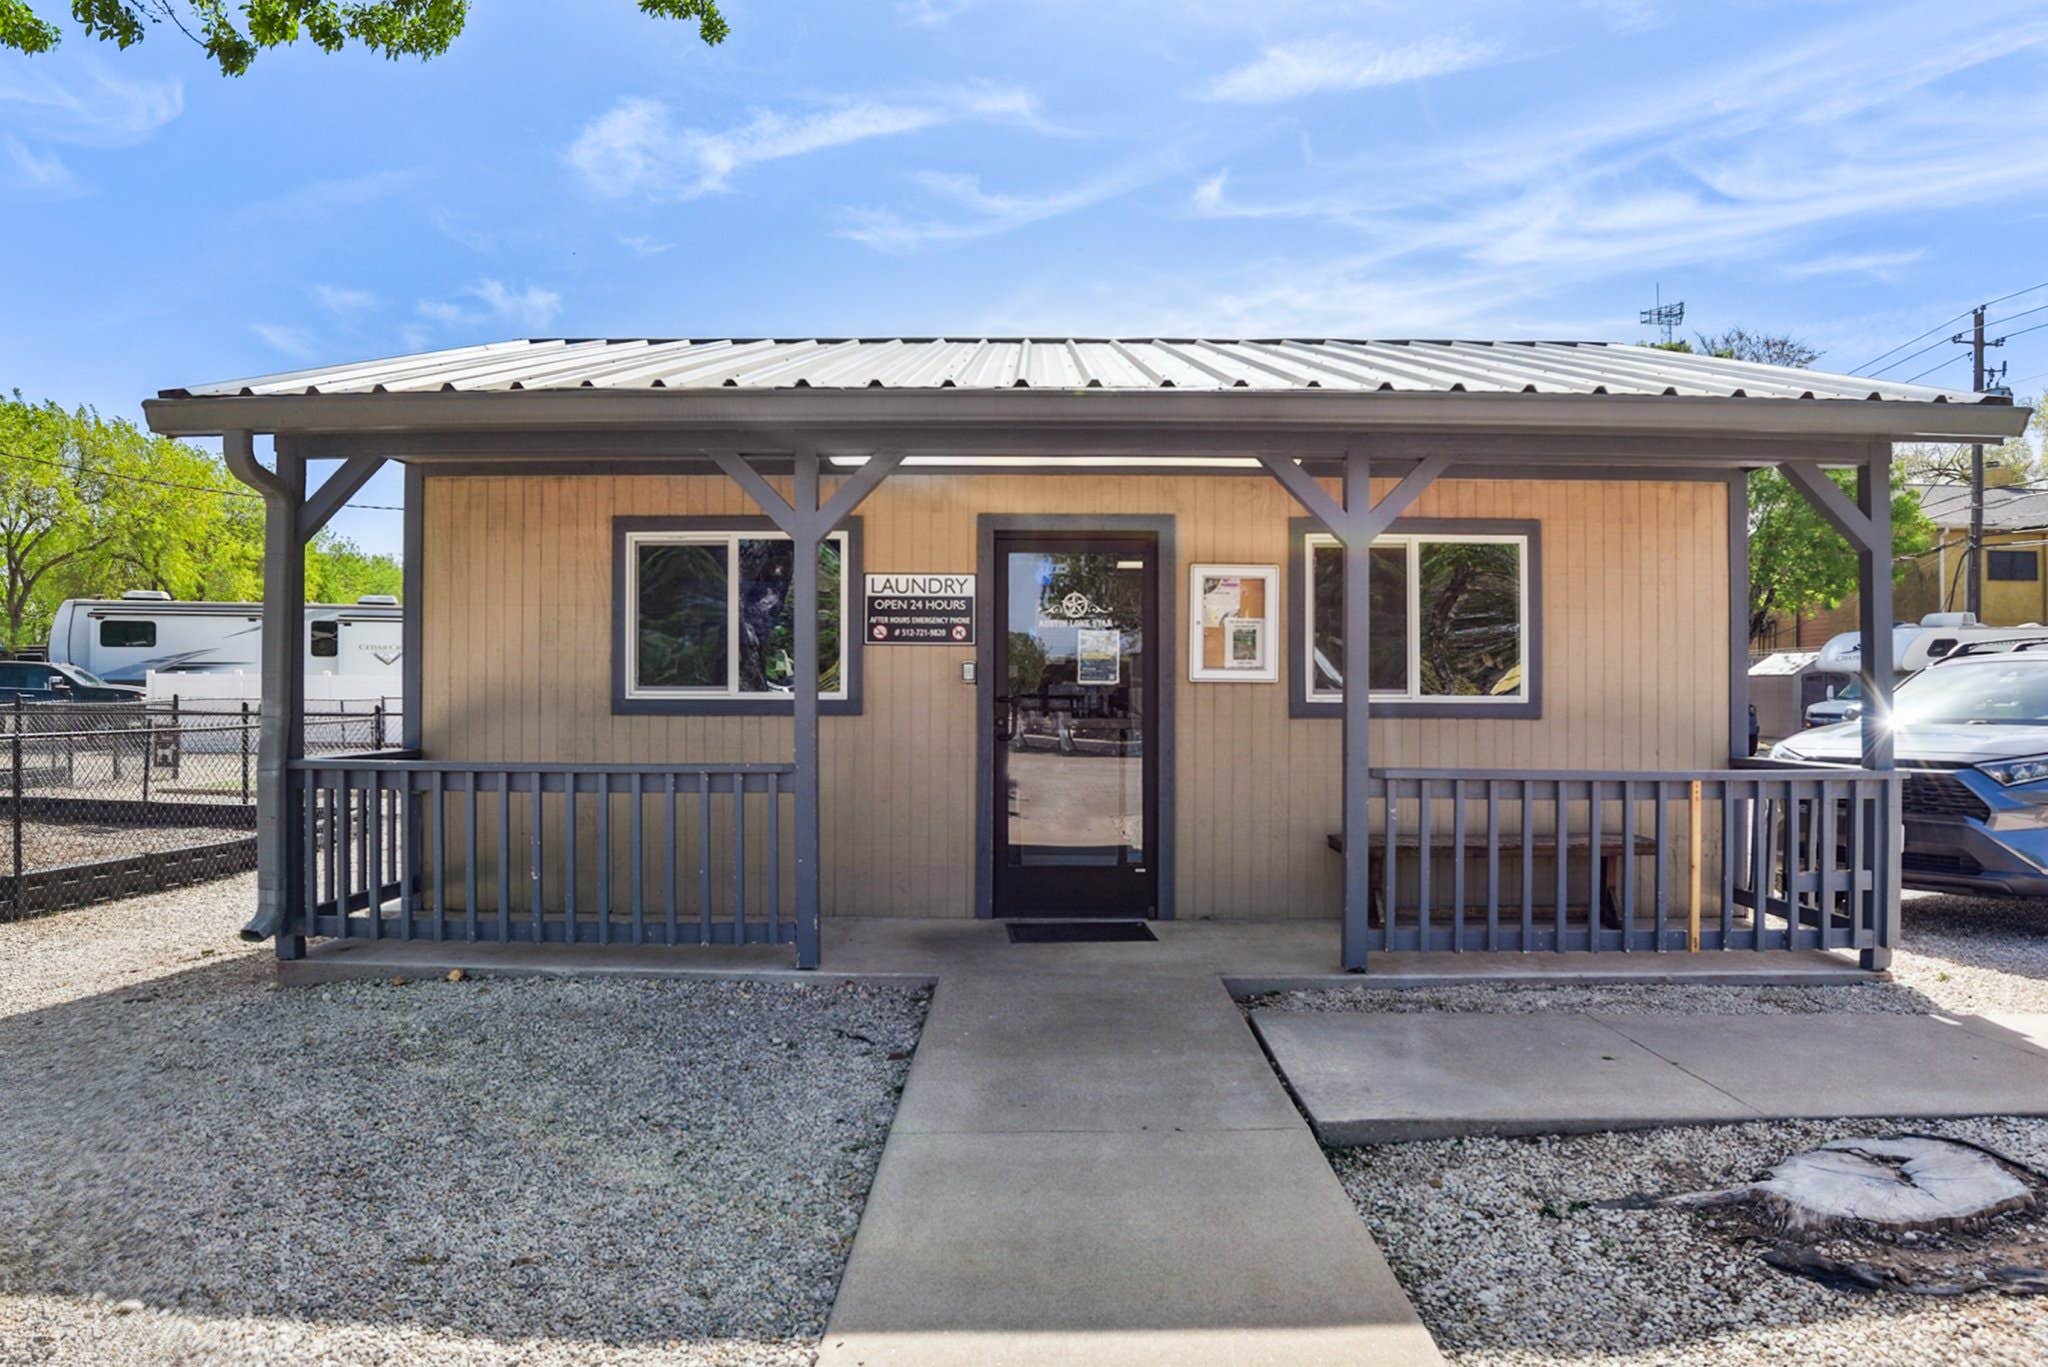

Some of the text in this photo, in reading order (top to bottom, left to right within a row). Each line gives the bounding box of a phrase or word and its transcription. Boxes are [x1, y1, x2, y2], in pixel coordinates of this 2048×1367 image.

[871, 578, 968, 594] LAUNDRY
[874, 599, 966, 610] OPEN 24 HOURS
[869, 616, 970, 624] AFTER HOURS EMERGENCY PHONE
[894, 628, 901, 636] #
